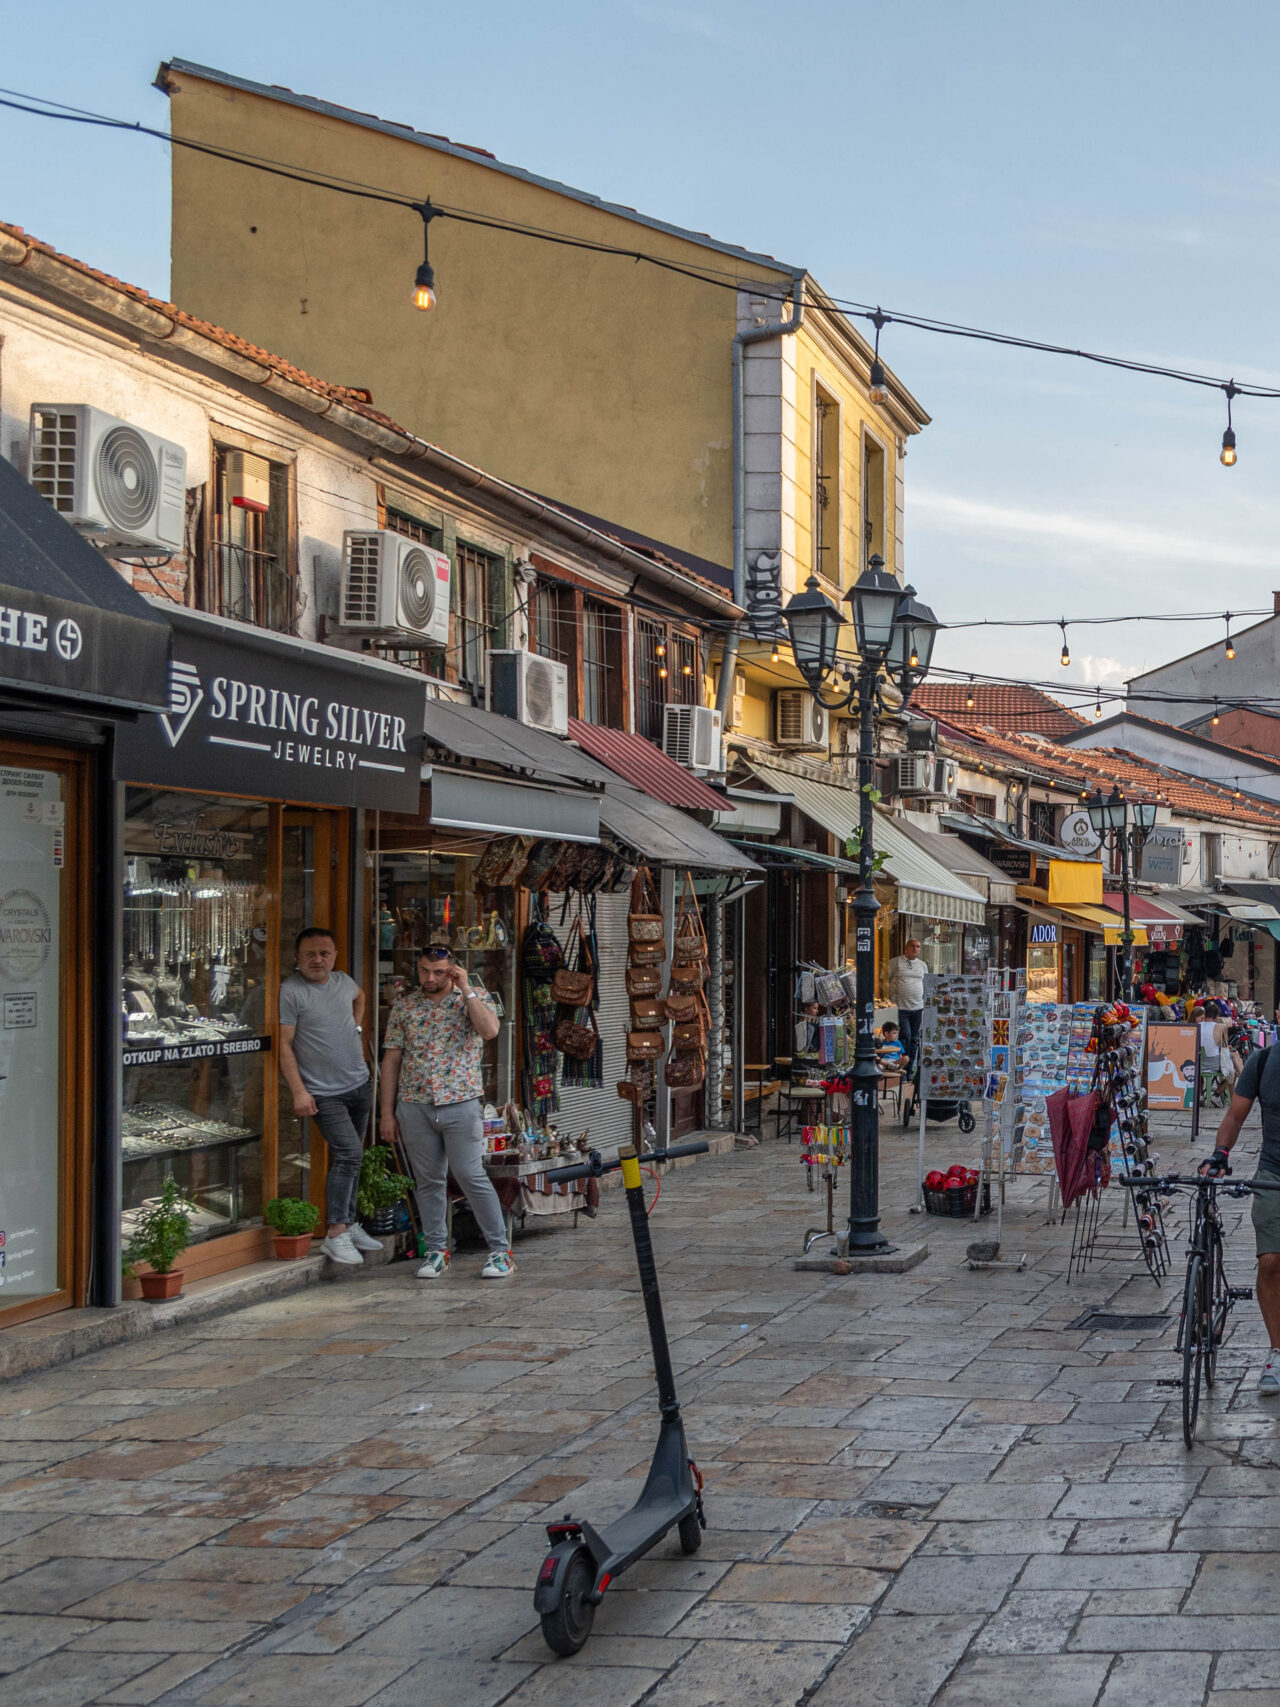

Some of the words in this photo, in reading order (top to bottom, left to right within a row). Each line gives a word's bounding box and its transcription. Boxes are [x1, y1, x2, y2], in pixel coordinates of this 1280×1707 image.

[211, 677, 319, 736] SPRING
[326, 702, 406, 752] SILVER
[274, 740, 357, 771] JEWELRY
[155, 813, 240, 857] Exclusive
[3, 908, 39, 917] CRYSTALS
[1032, 925, 1057, 942] ADOR
[123, 1050, 161, 1065] OTKUP
[164, 1048, 180, 1060] NA
[182, 1045, 214, 1058] ZLATO
[216, 1043, 221, 1054] I
[223, 1039, 261, 1053] SREBRO
